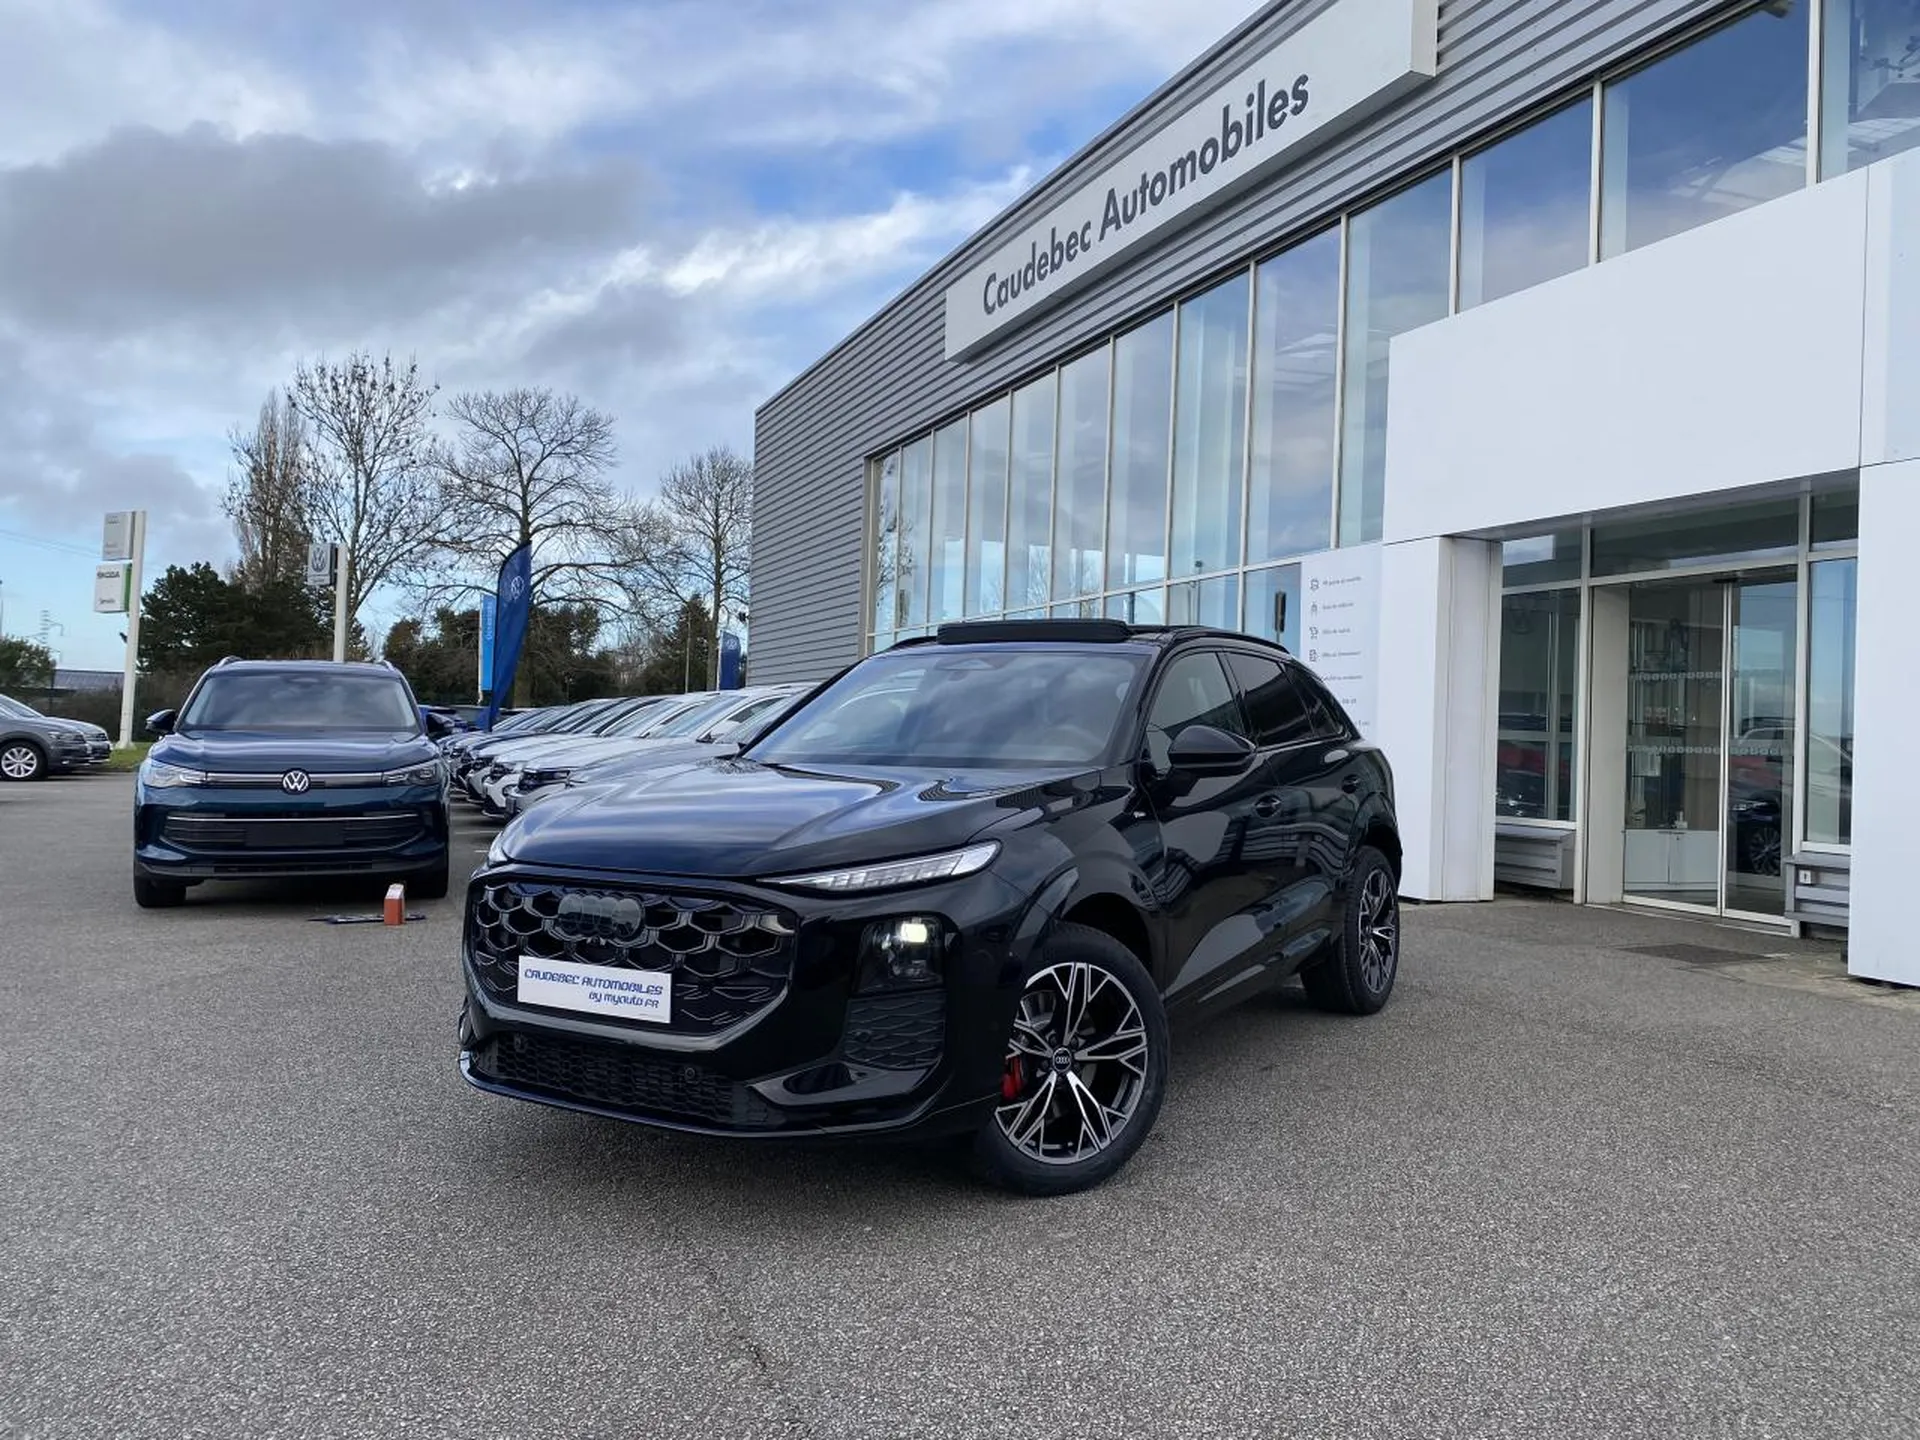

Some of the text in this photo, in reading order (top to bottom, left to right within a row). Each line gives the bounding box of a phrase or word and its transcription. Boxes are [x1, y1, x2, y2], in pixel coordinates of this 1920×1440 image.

[983, 73, 1309, 316] Caudebec Automobiles
[524, 968, 664, 996] CAUDEBEC AUTOMOBILES
